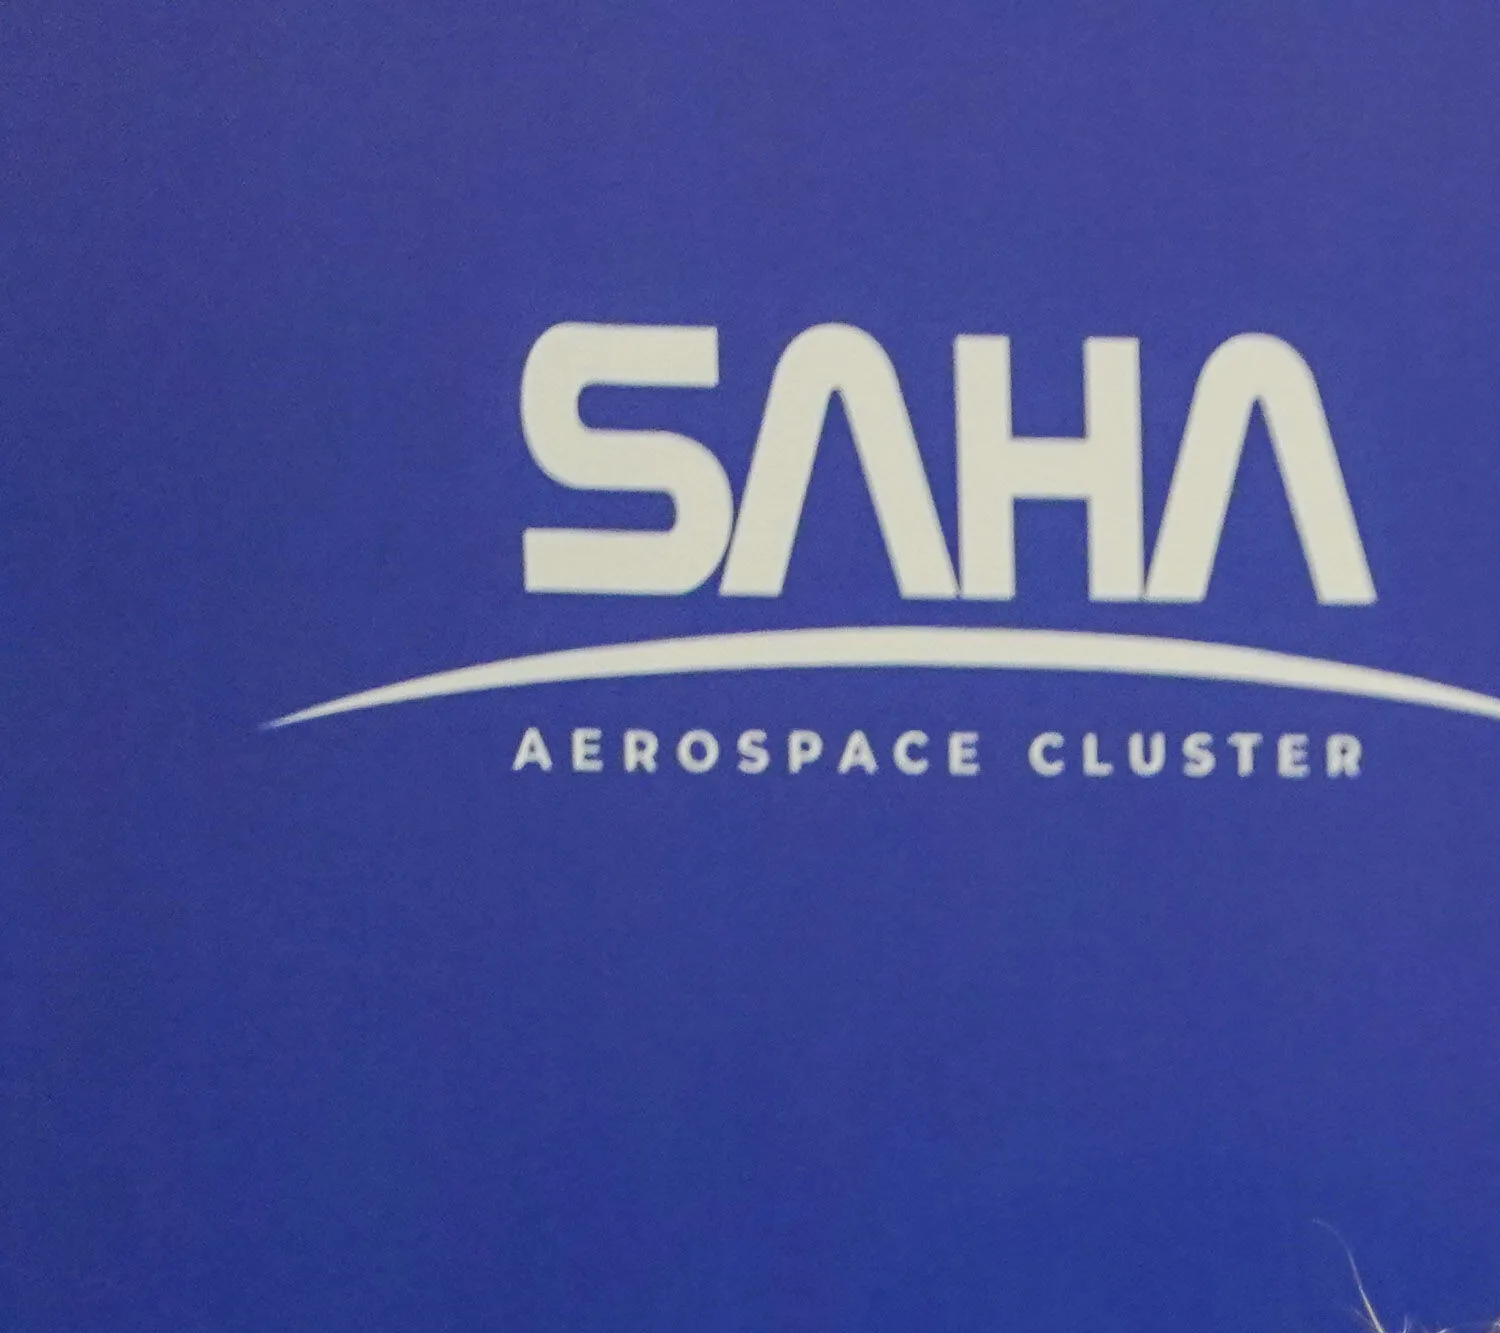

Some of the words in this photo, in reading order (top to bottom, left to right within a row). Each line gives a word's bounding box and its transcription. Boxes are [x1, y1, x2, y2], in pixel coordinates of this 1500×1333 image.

[520, 320, 1379, 605] SAHA
[511, 726, 980, 775] AEROSPACE
[1028, 731, 1363, 778] CLUSTER
